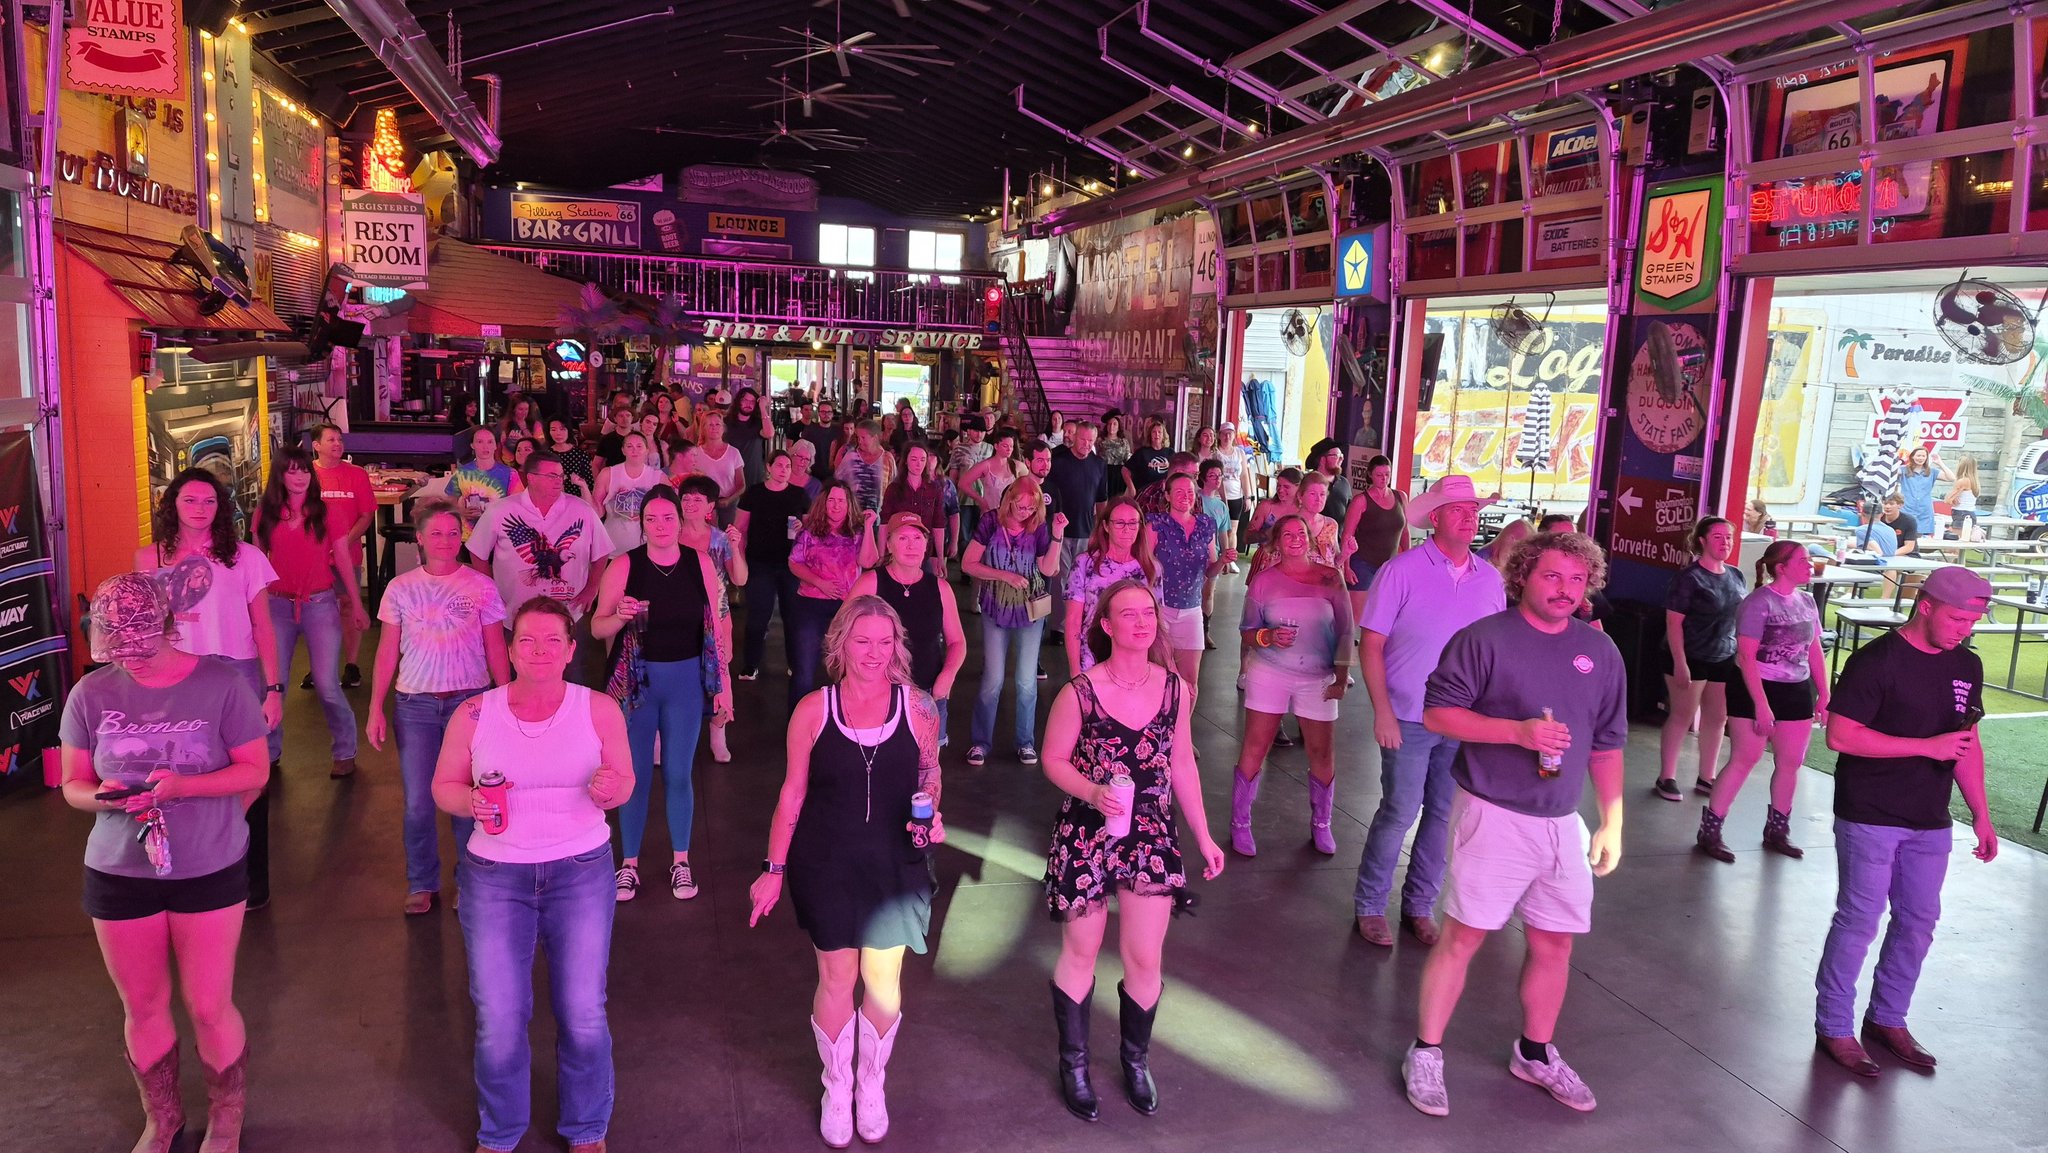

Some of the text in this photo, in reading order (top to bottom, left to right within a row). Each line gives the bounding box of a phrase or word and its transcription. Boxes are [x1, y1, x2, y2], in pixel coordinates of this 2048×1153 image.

[87, 26, 156, 43] STAMPS
[1830, 119, 1852, 129] ROUTE
[1828, 129, 1850, 150] 66
[1545, 179, 1585, 197] QUALITY
[351, 202, 417, 212] REGISTERED
[520, 203, 612, 220] Filling Station
[620, 210, 634, 220] 66
[354, 221, 415, 243] REST
[517, 217, 562, 241] BAR
[572, 221, 637, 245] GRILL
[715, 216, 779, 233] LOUNGE
[1646, 198, 1704, 260] S&H
[1543, 227, 1570, 241] EXIDE
[1550, 237, 1599, 253] BATTERIES
[351, 244, 421, 265] ROOM
[1646, 261, 1695, 274] GREEN
[1644, 273, 1693, 285] STAMPS
[702, 319, 984, 350] TIRE & AUTO SERVICE
[1079, 328, 1177, 363] RESTAURANT
[1639, 395, 1654, 408] DU
[1637, 412, 1696, 444] STATE FAIR
[1655, 497, 1694, 510] bloomington
[1655, 506, 1694, 525] GOLD
[1655, 523, 1681, 533] Corvettes
[1611, 532, 1658, 560] Corvette
[95, 710, 209, 735] Bronco
